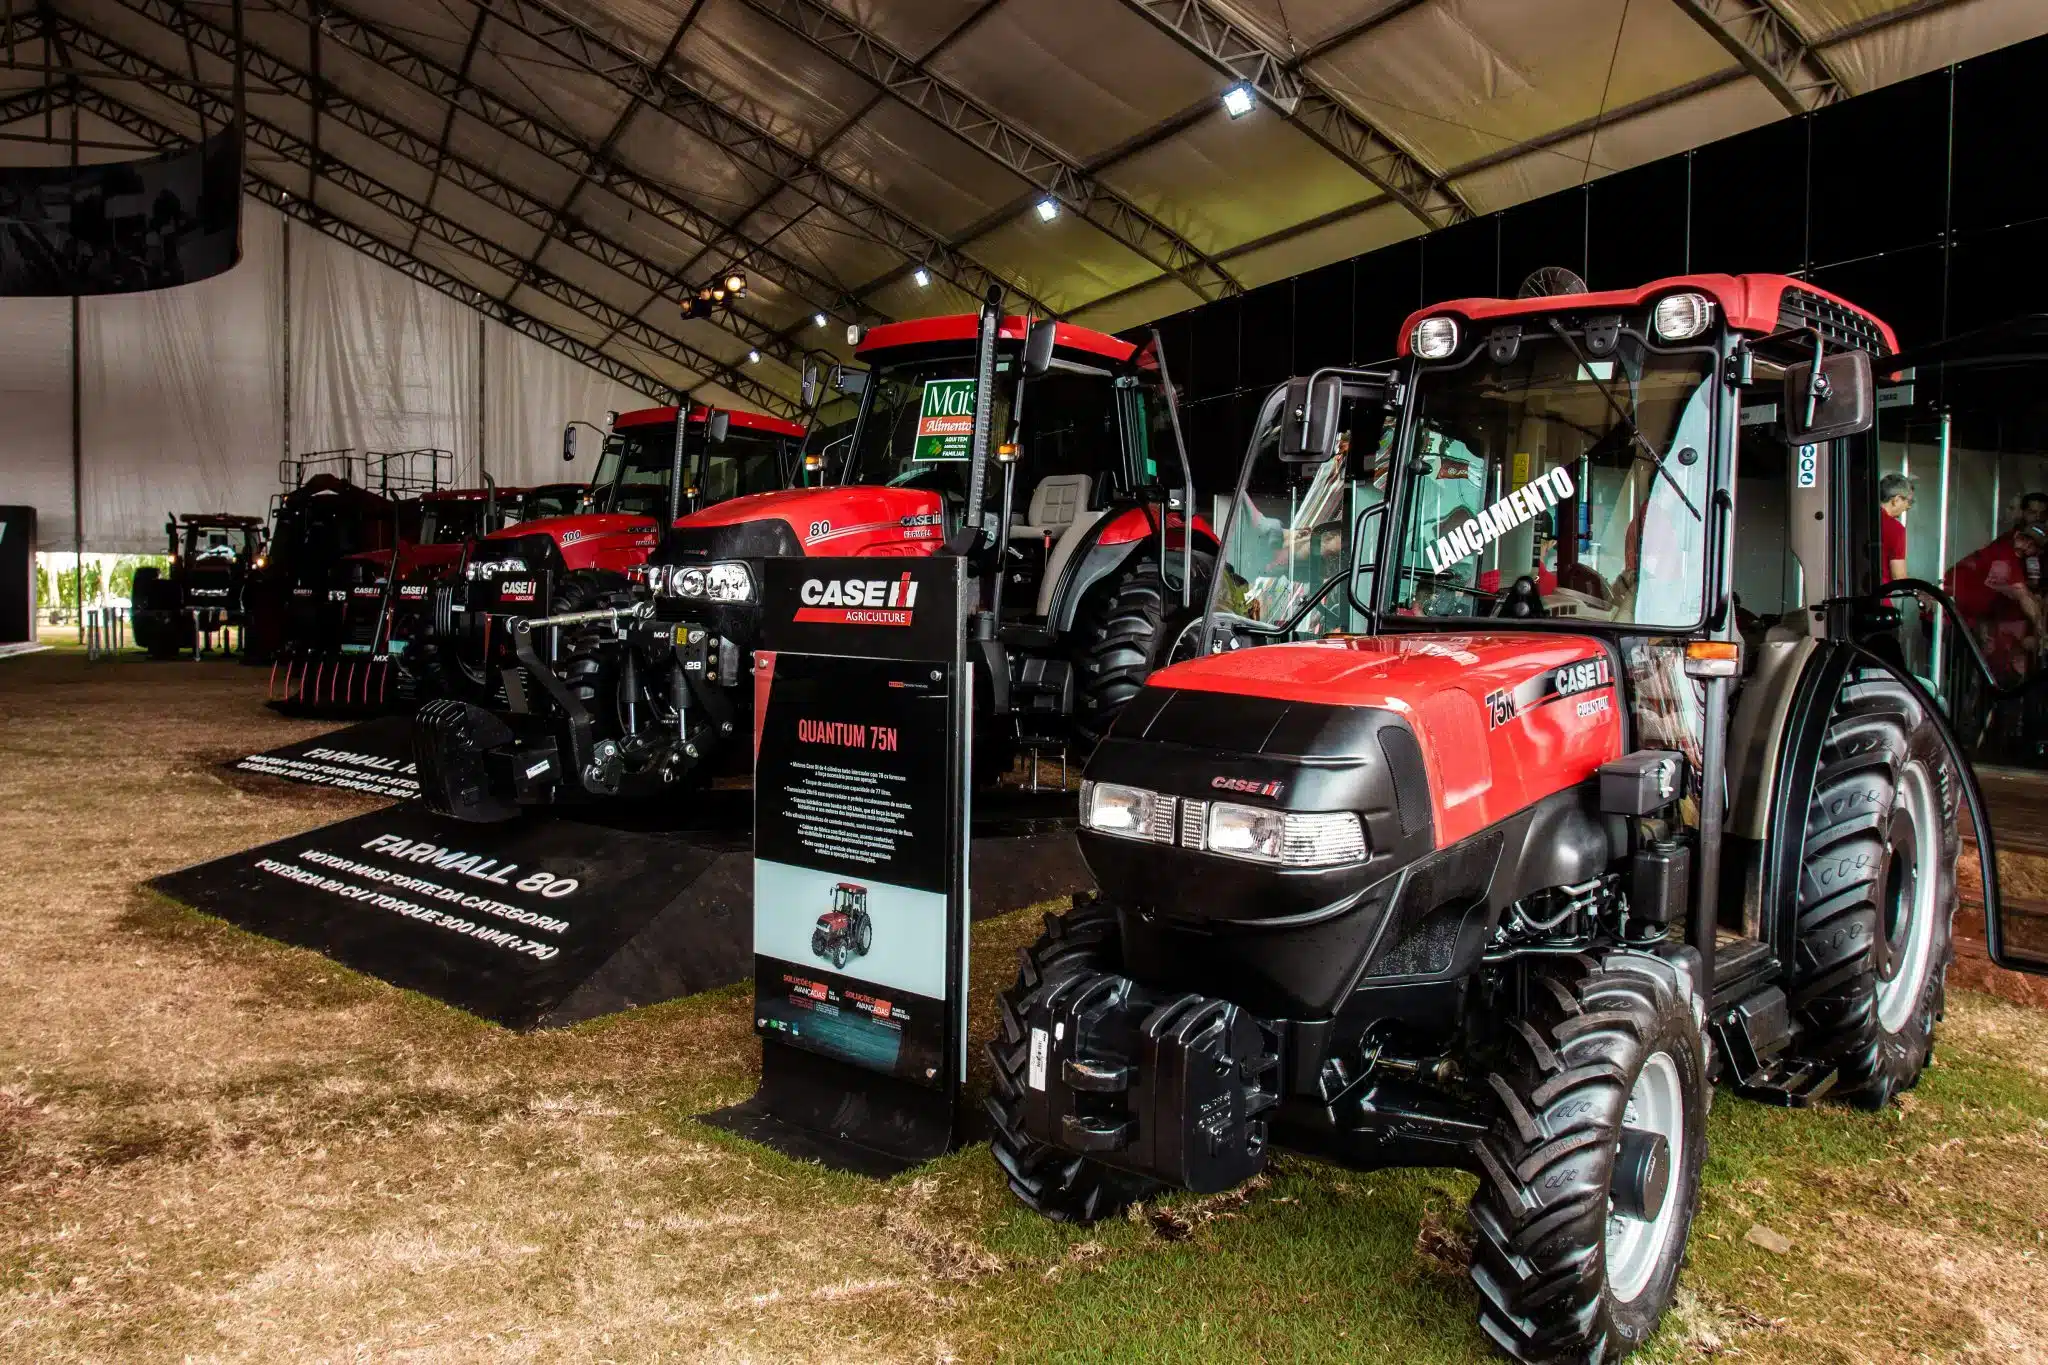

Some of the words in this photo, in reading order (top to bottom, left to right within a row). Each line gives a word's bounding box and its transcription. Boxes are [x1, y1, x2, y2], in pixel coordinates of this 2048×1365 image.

[810, 520, 830, 537] 80
[900, 514, 932, 526] CASE
[1426, 466, 1574, 575] LANÇAMENTO
[562, 530, 581, 542] 100
[400, 586, 421, 595] CASE
[502, 582, 527, 594] CASE
[800, 578, 887, 606] CASE
[846, 612, 906, 622] AGRICULTURE
[1555, 661, 1596, 696] CASE
[1485, 688, 1516, 732] 75N
[798, 719, 865, 748] QUANTUM
[870, 726, 897, 752] 75N
[302, 748, 400, 770] FARMALL
[1211, 776, 1260, 793] CASE
[361, 834, 518, 885] FARMALL
[516, 872, 578, 898] 80
[254, 859, 326, 887] POTÊNCIA
[320, 880, 345, 892] 80
[370, 894, 444, 922] TORQUE
[436, 915, 476, 933] 300
[299, 850, 356, 872] MOTOR
[352, 864, 390, 882] MAIS
[384, 874, 442, 896] FORTE
[435, 888, 465, 903] DA
[461, 896, 570, 934] CATEGORIA
